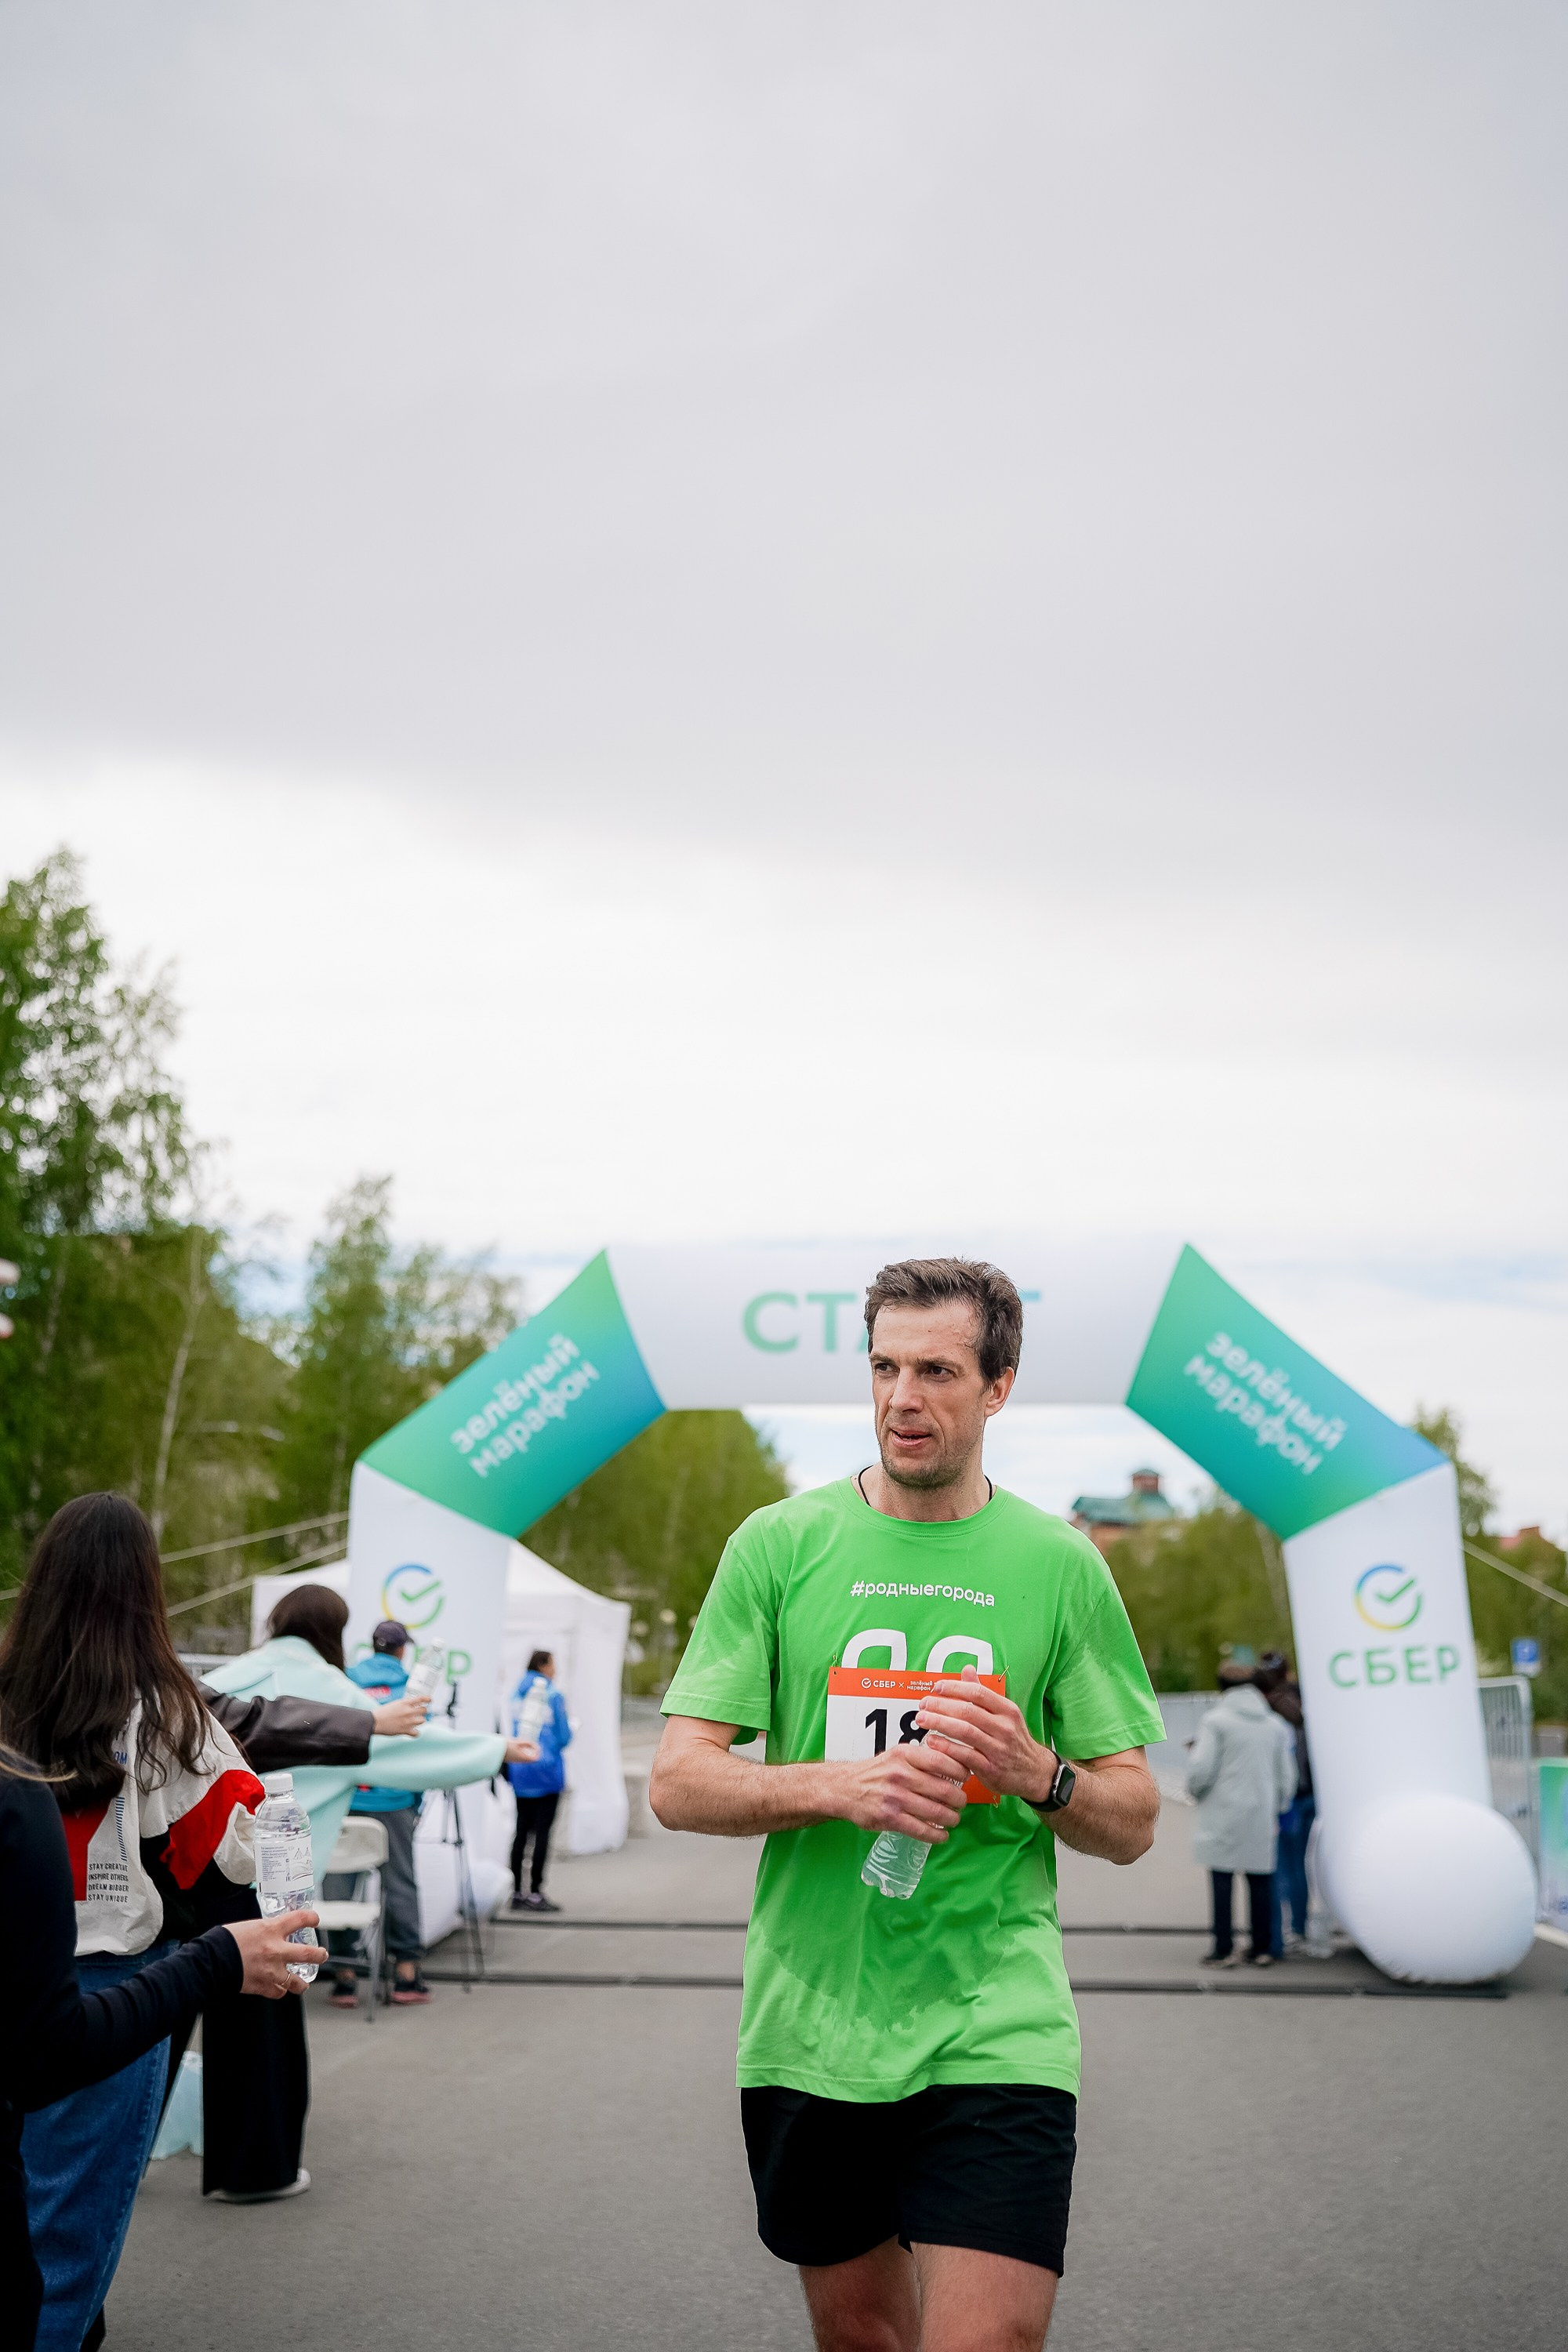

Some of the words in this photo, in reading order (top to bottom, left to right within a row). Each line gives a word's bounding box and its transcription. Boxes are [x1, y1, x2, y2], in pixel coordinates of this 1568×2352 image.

[449, 1333, 581, 1455] зелёный
[1184, 1354, 1323, 1475] марафон
[1205, 1332, 1347, 1452] зелёный
[468, 1360, 601, 1478] марафон
[850, 1580, 995, 1607] #родныегорода
[1329, 1645, 1461, 1690] СБЕР
[104, 1863, 128, 1872] CREATIVE
[111, 1873, 129, 1882] OTHERS
[106, 1894, 128, 1903] UNIQUE
